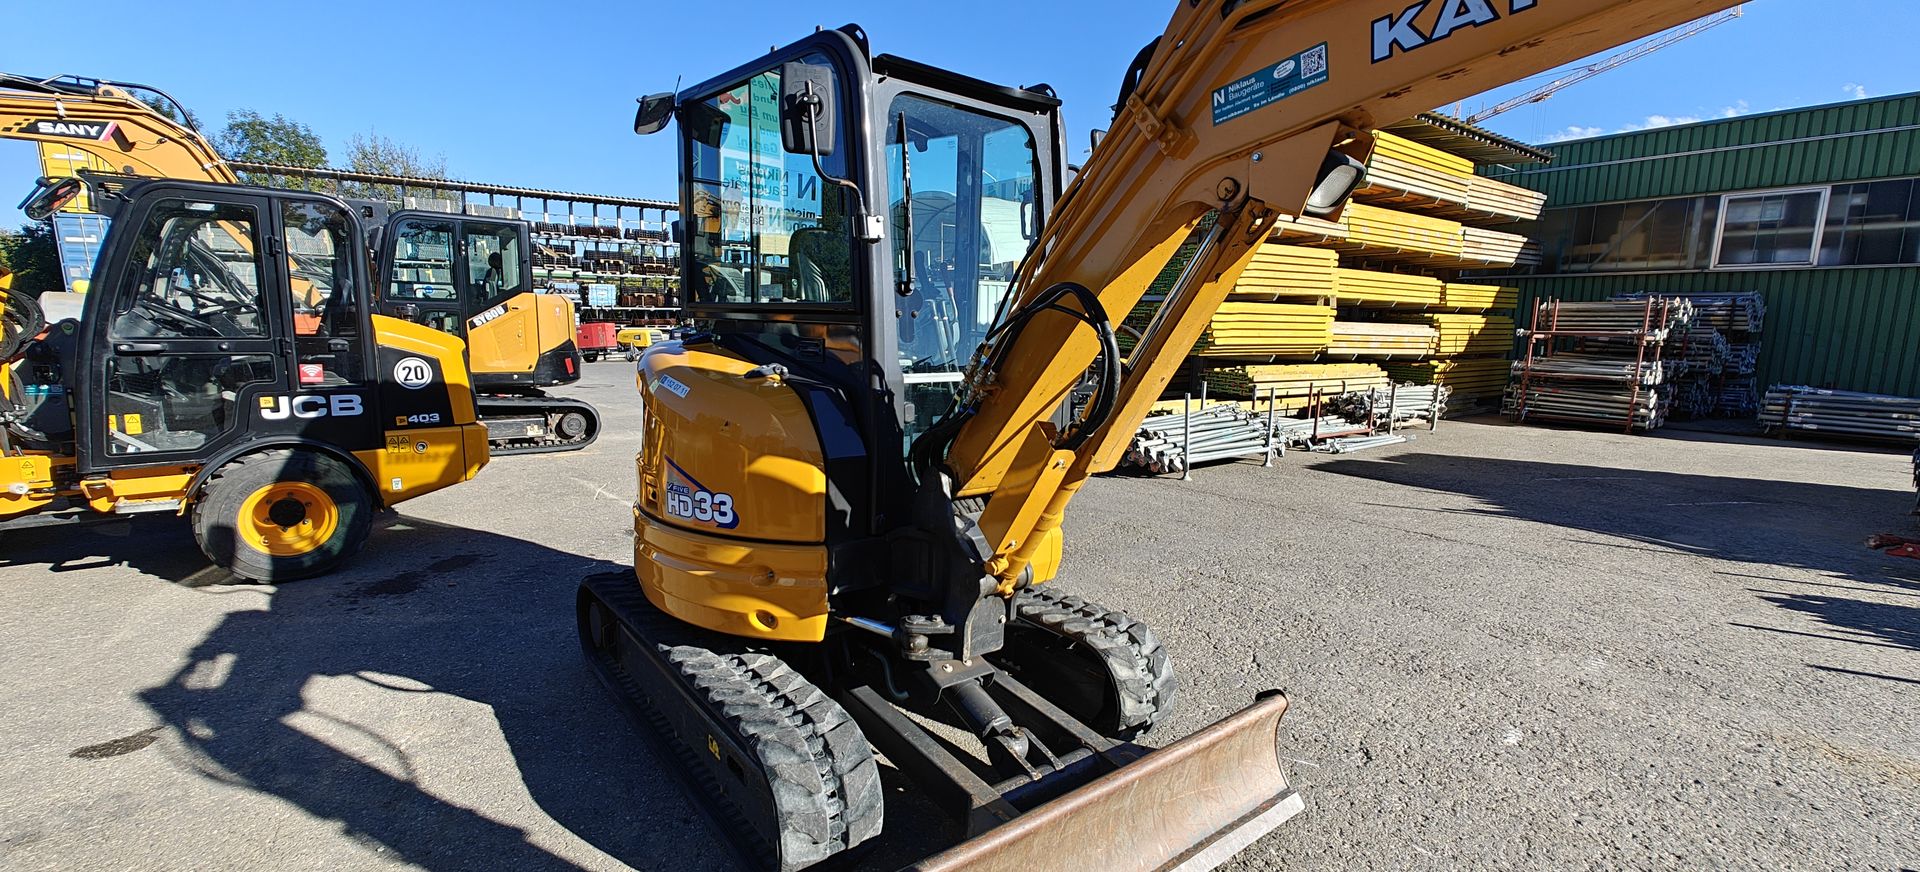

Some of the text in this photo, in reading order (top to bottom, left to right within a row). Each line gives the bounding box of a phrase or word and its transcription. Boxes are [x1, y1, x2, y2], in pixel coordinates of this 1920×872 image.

[1228, 77, 1256, 93] Niklaus
[1228, 81, 1265, 101] Baugeräte
[1213, 89, 1225, 107] N
[37, 121, 100, 136] SANY
[402, 365, 425, 382] 20
[261, 394, 364, 420] JCB
[408, 413, 440, 423] 403
[667, 490, 735, 525] HD33
